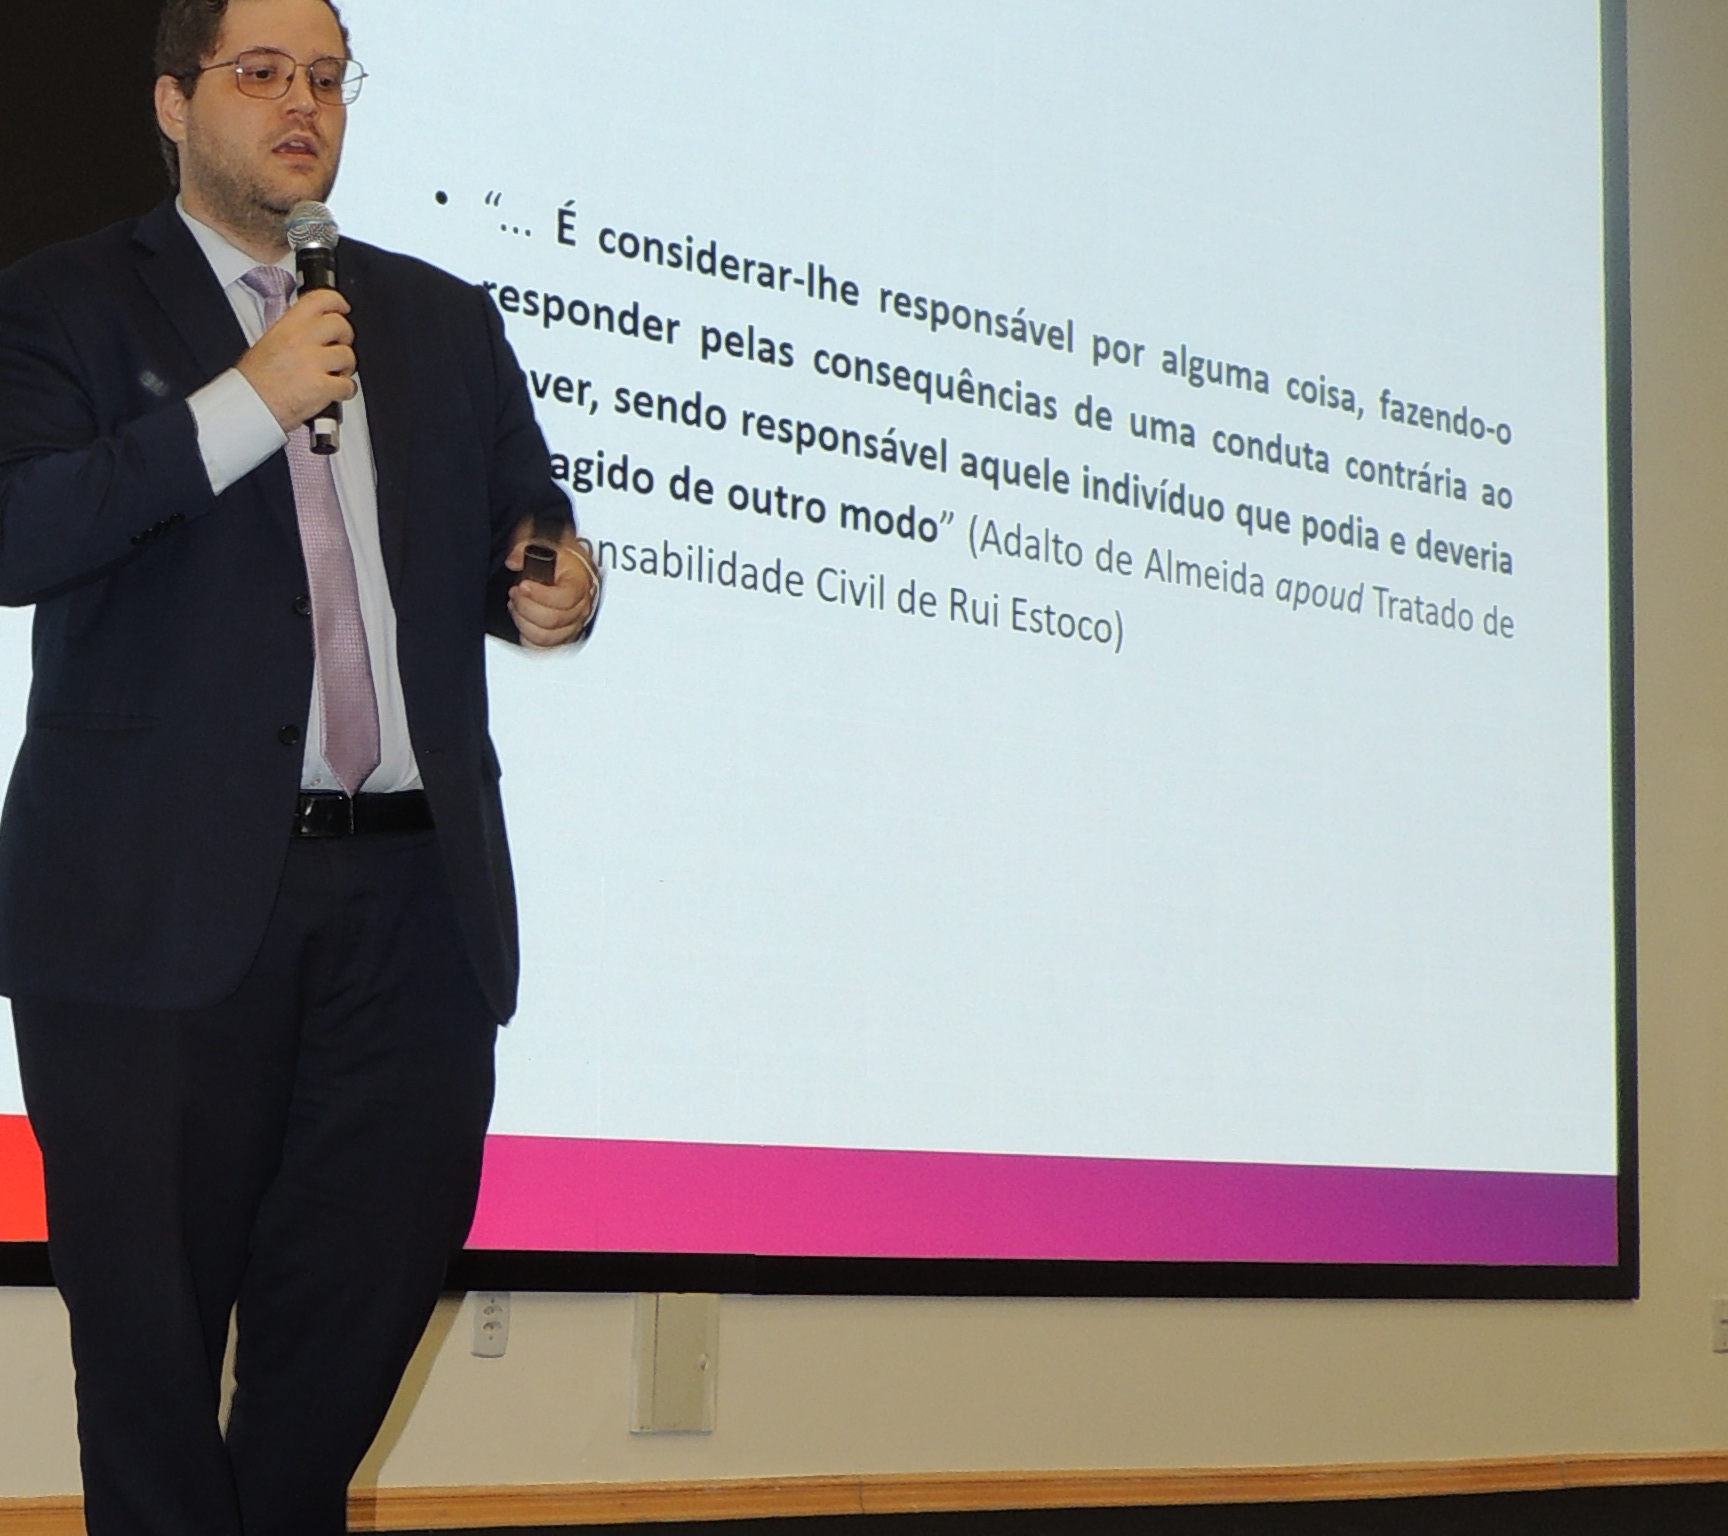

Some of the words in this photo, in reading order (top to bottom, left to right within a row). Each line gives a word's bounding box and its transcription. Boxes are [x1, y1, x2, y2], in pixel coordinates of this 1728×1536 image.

[481, 279, 681, 346] responder
[701, 324, 795, 368] pelas
[813, 348, 1058, 421] consequências
[1074, 394, 1113, 432] de
[1130, 412, 1196, 449] uma
[1212, 430, 1330, 475] conduta
[1345, 456, 1467, 501] contrária
[1481, 483, 1513, 510] ao
[557, 199, 577, 247] É
[598, 227, 860, 307] considerar-lhe
[880, 287, 1074, 354] responsável
[1092, 334, 1146, 368] por
[1161, 343, 1270, 395] alguma
[1286, 374, 1364, 421] coisa,
[1379, 388, 1512, 446] fazendo-o
[549, 449, 655, 496] agido
[668, 464, 714, 506] de
[727, 483, 827, 524] outro
[969, 514, 1083, 568] (Adalto
[1095, 538, 1133, 576] de
[1144, 547, 1264, 598] Almeida
[1275, 578, 1365, 614] apoud
[1372, 585, 1474, 632] Tratado
[1483, 605, 1514, 639] de
[614, 387, 727, 431] sendo
[741, 409, 947, 474] responsável
[960, 452, 1070, 495] aquele
[1082, 464, 1225, 523] indivíduo
[1235, 503, 1291, 537] que
[1302, 514, 1380, 551] podia
[1390, 532, 1406, 556] e
[1416, 528, 1513, 576] deveria
[816, 566, 885, 611] Civil
[897, 578, 937, 618] de
[950, 587, 999, 628] Rui
[1012, 596, 1123, 654] Estoco)
